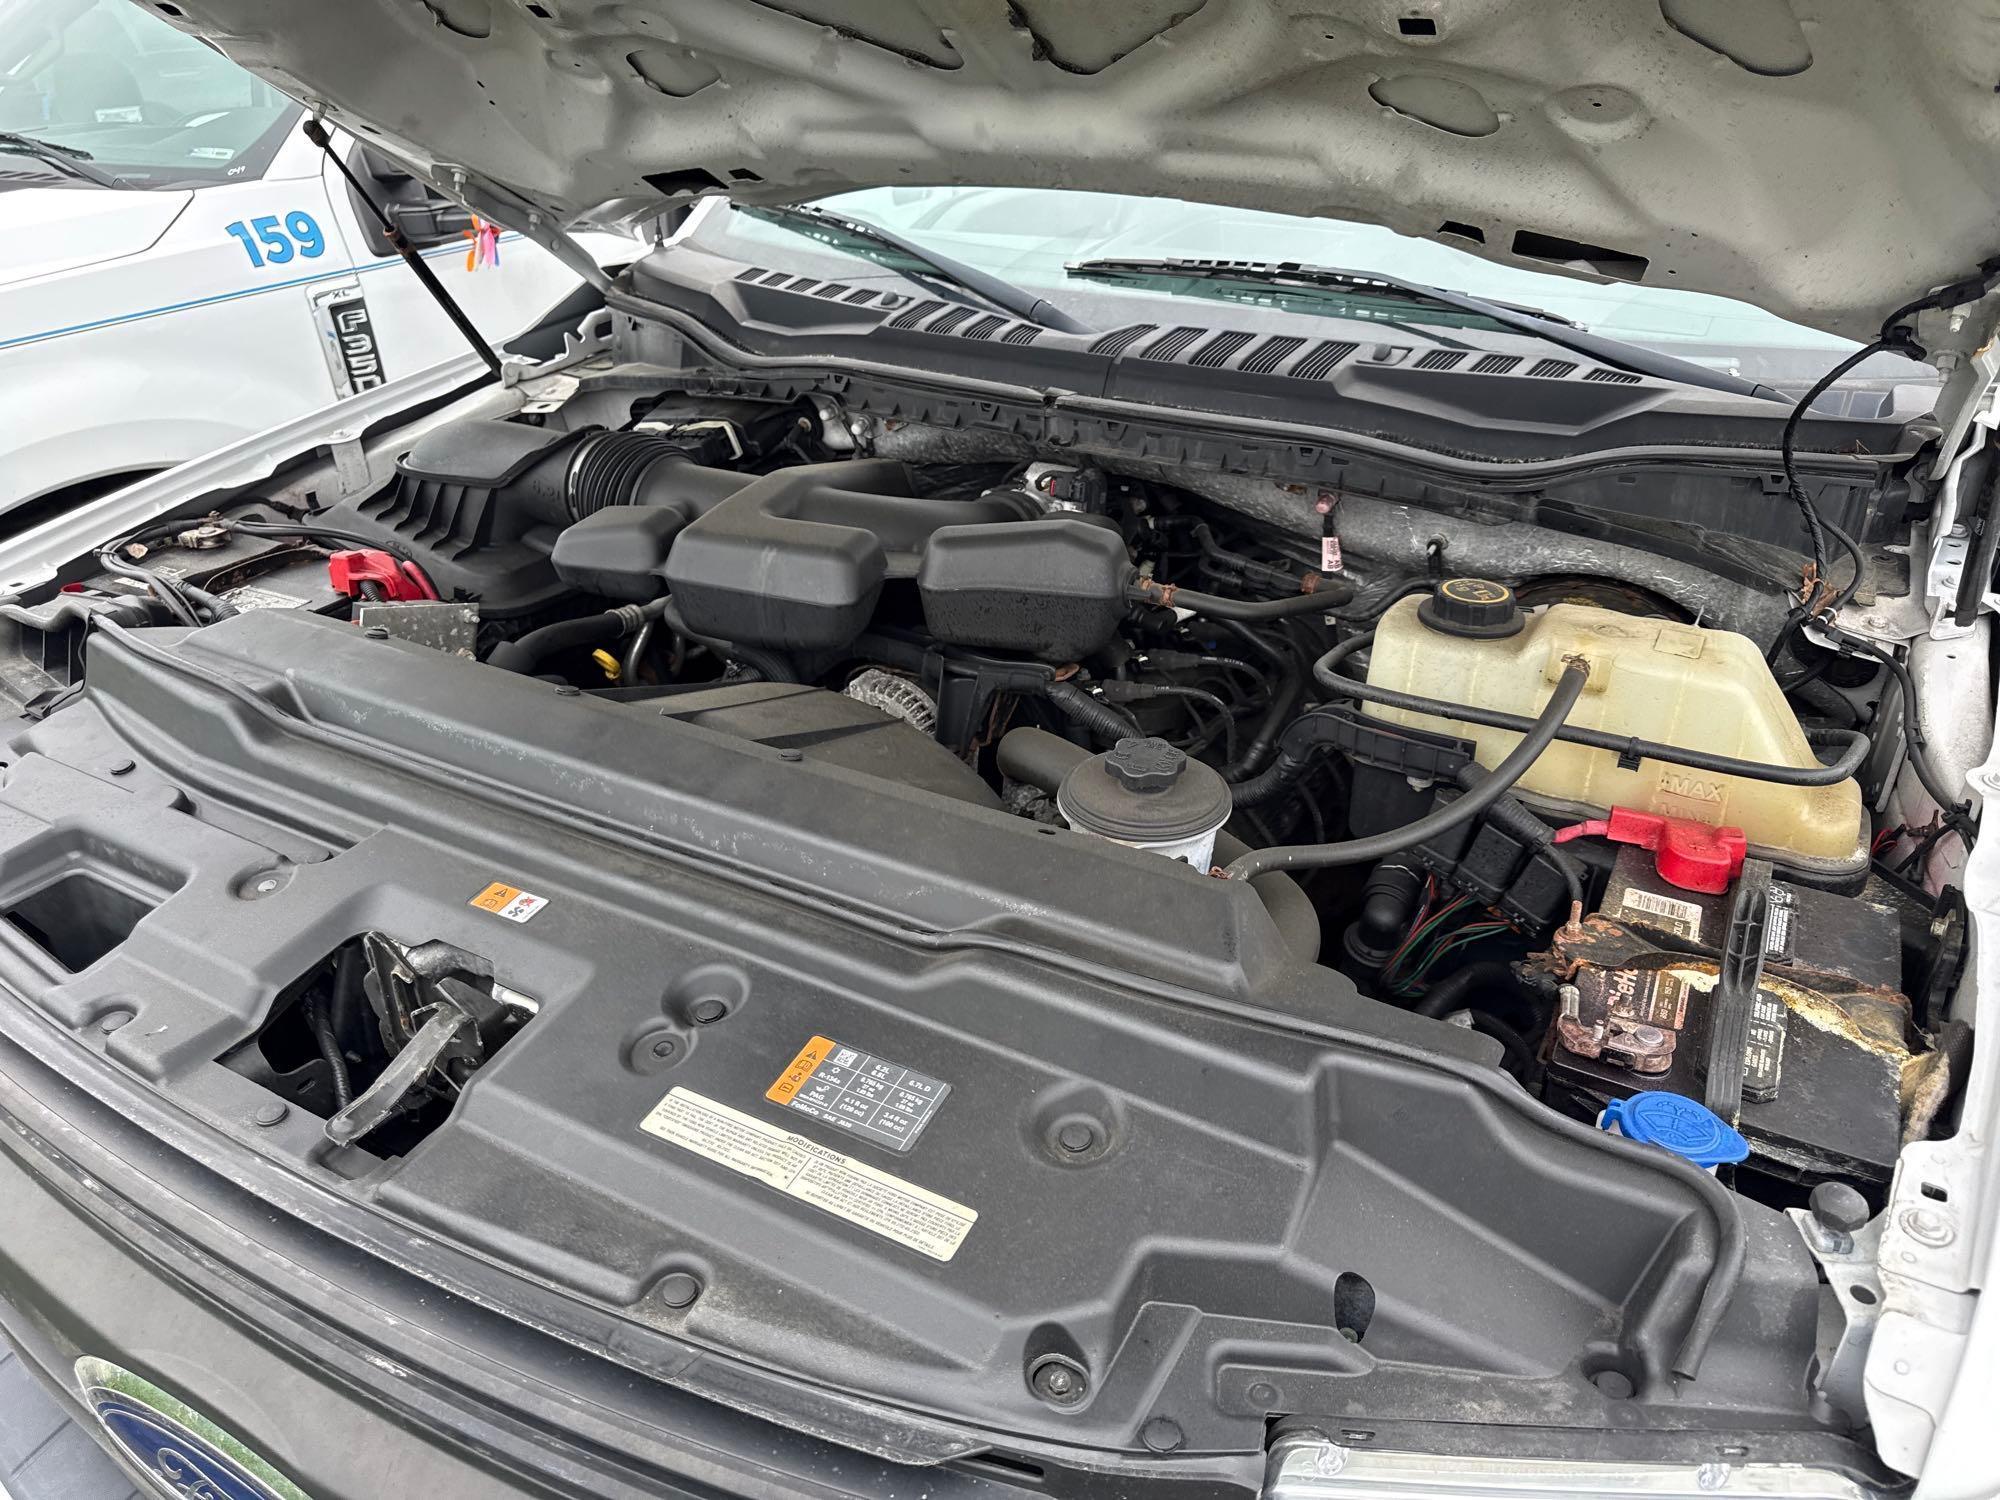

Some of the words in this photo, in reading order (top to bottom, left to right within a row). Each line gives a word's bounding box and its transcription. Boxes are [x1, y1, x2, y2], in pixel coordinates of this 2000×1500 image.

[224, 210, 326, 268] 159
[332, 290, 350, 300] XL
[1670, 774, 1725, 802] MAX
[876, 1064, 890, 1074] 6.2L
[818, 1072, 840, 1084] R-134a
[909, 1080, 923, 1089] 6.7L
[809, 1091, 825, 1100] PAG
[791, 1100, 819, 1115] FoMoCo
[786, 1135, 847, 1165] MODIFICATIONS
